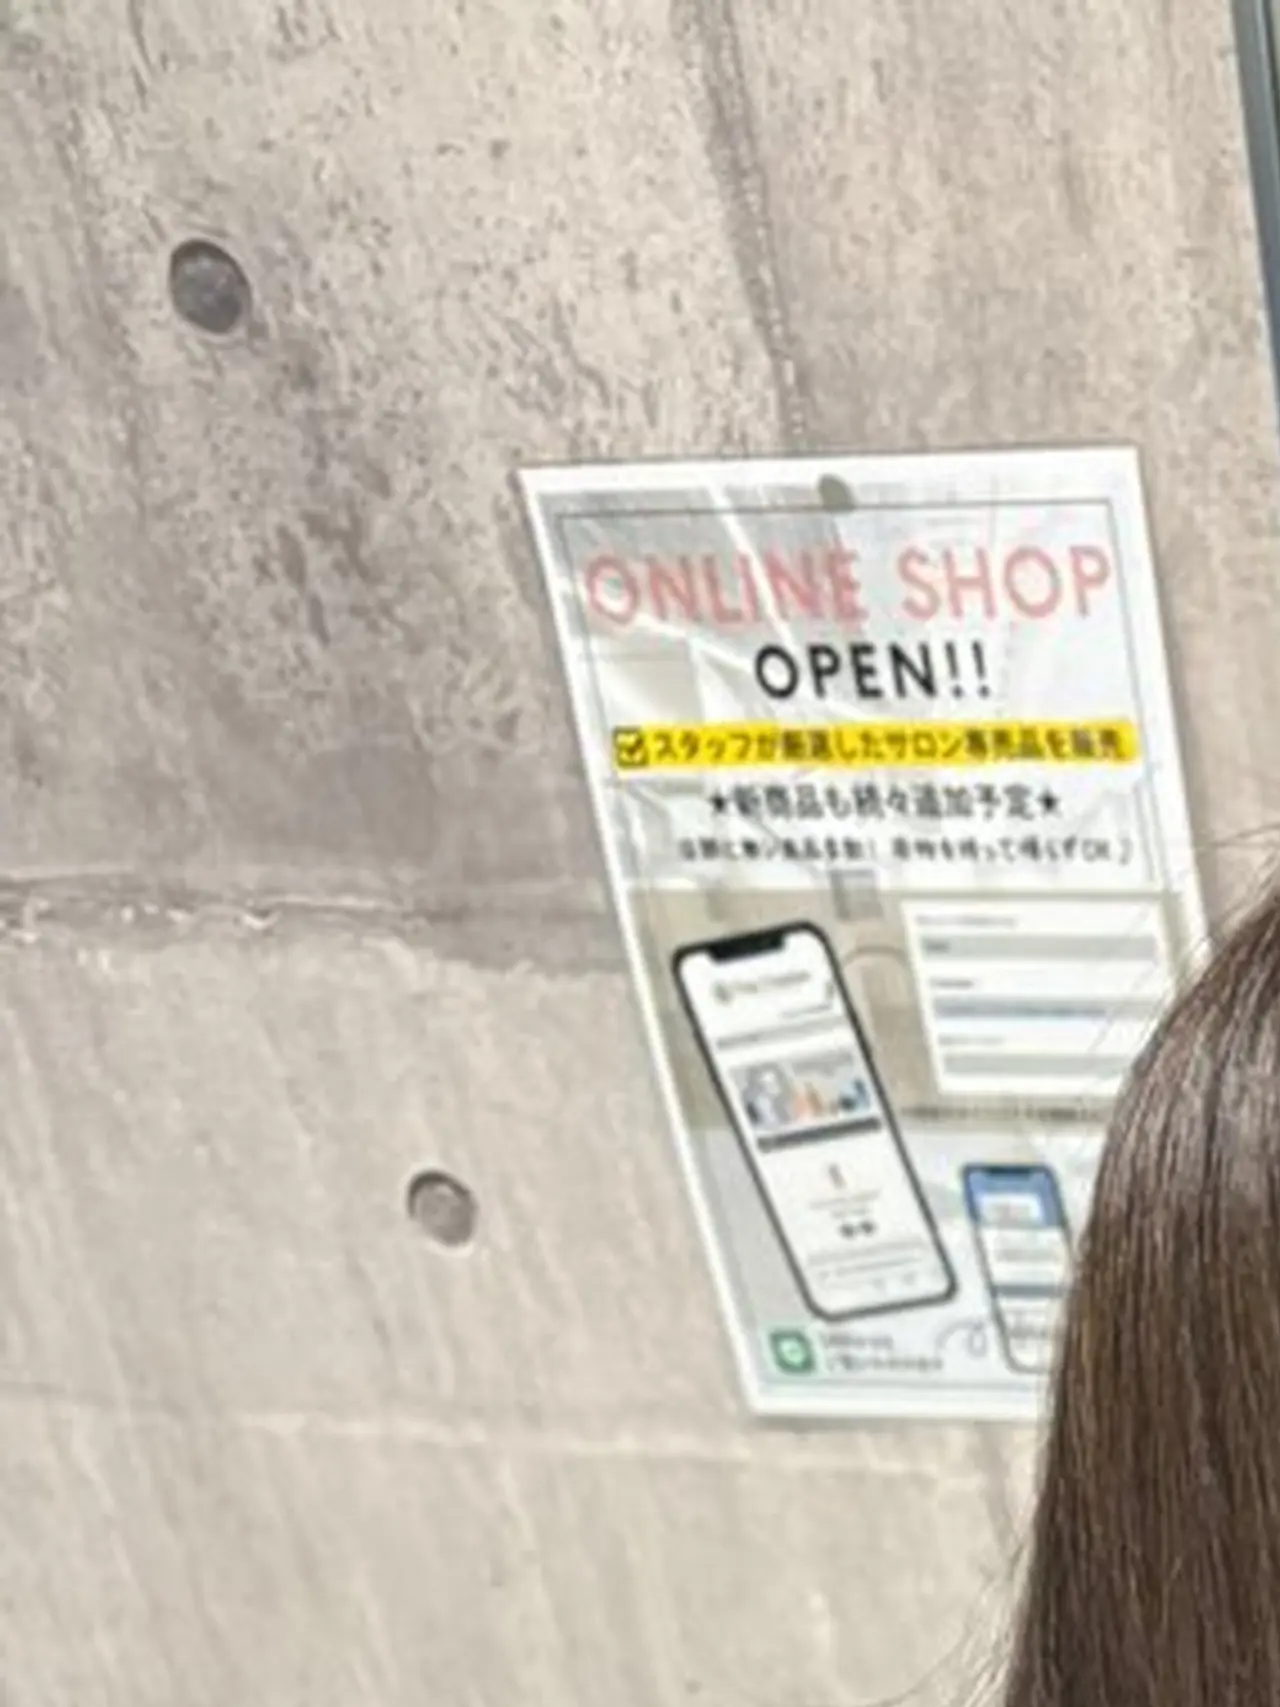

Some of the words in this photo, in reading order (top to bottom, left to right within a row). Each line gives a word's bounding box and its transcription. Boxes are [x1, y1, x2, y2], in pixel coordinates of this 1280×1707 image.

[586, 550, 868, 625] ONLINE
[897, 545, 1111, 620] SHOP
[755, 640, 991, 699] OPEN!!
